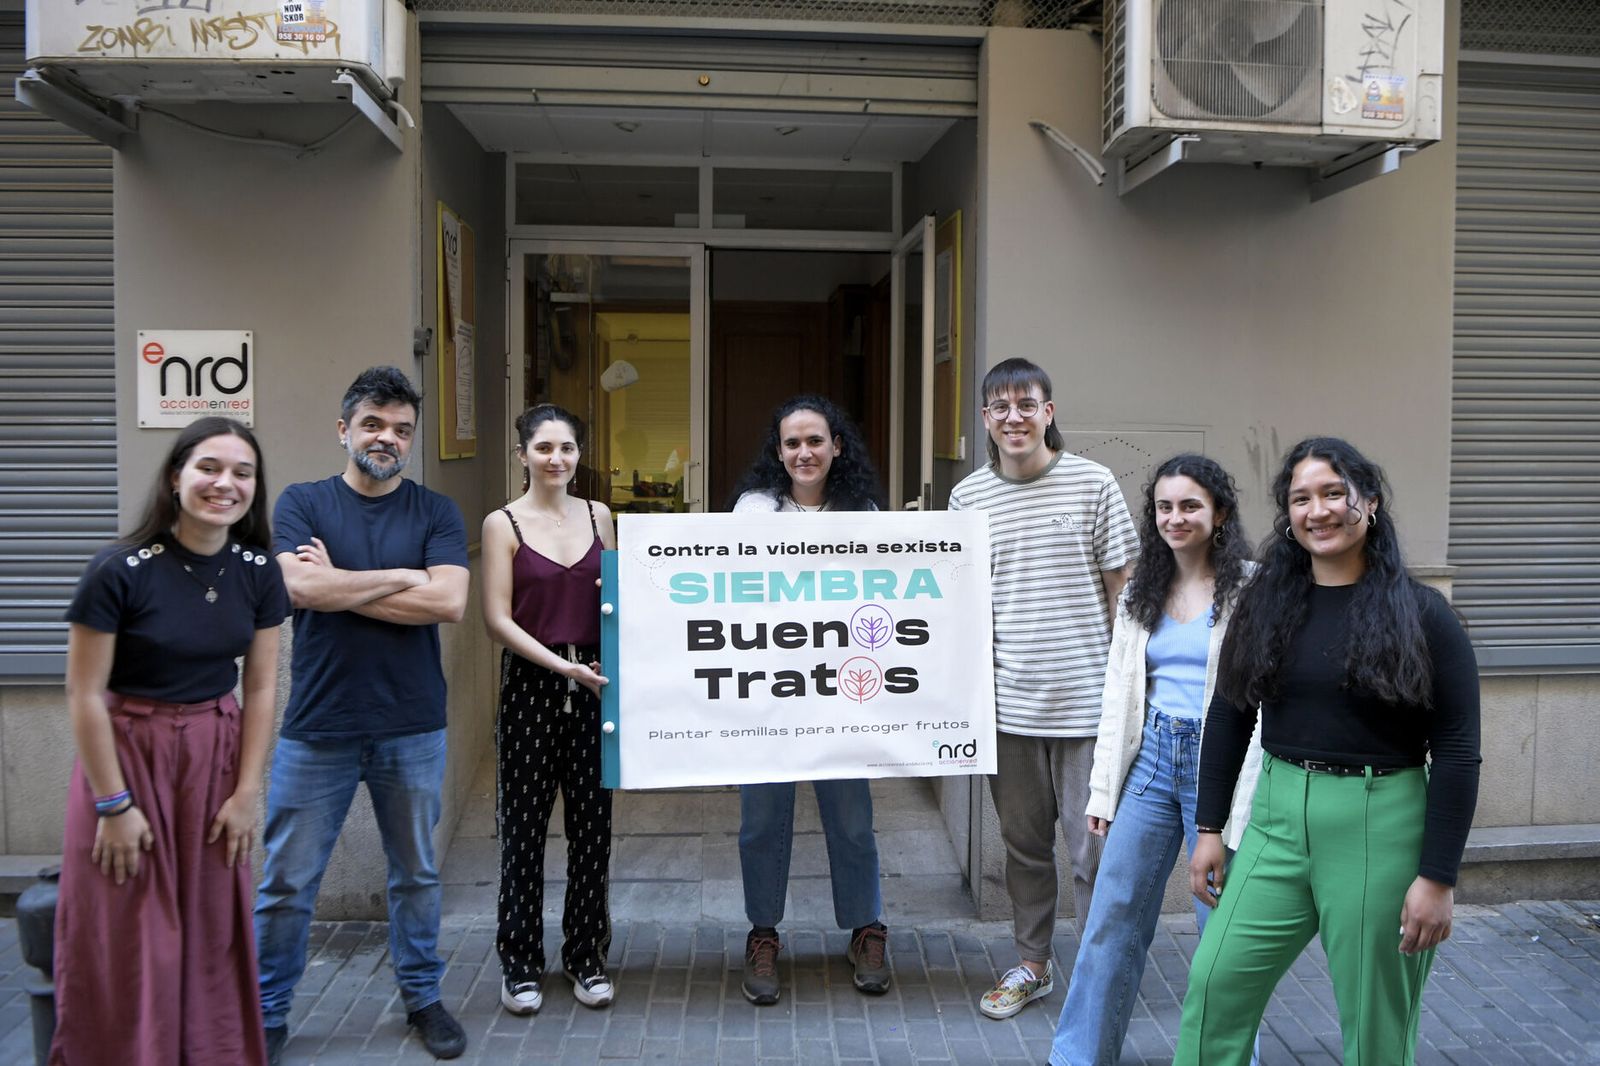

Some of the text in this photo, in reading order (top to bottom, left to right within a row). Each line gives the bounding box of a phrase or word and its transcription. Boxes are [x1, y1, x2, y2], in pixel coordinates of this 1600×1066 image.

[284, 4, 302, 13] NOW
[160, 400, 250, 409] accionenred
[648, 540, 962, 557] Contra la violencia sexista
[669, 568, 944, 605] SIEMBRA
[649, 720, 970, 740] Plantar semillas para recoger frutos
